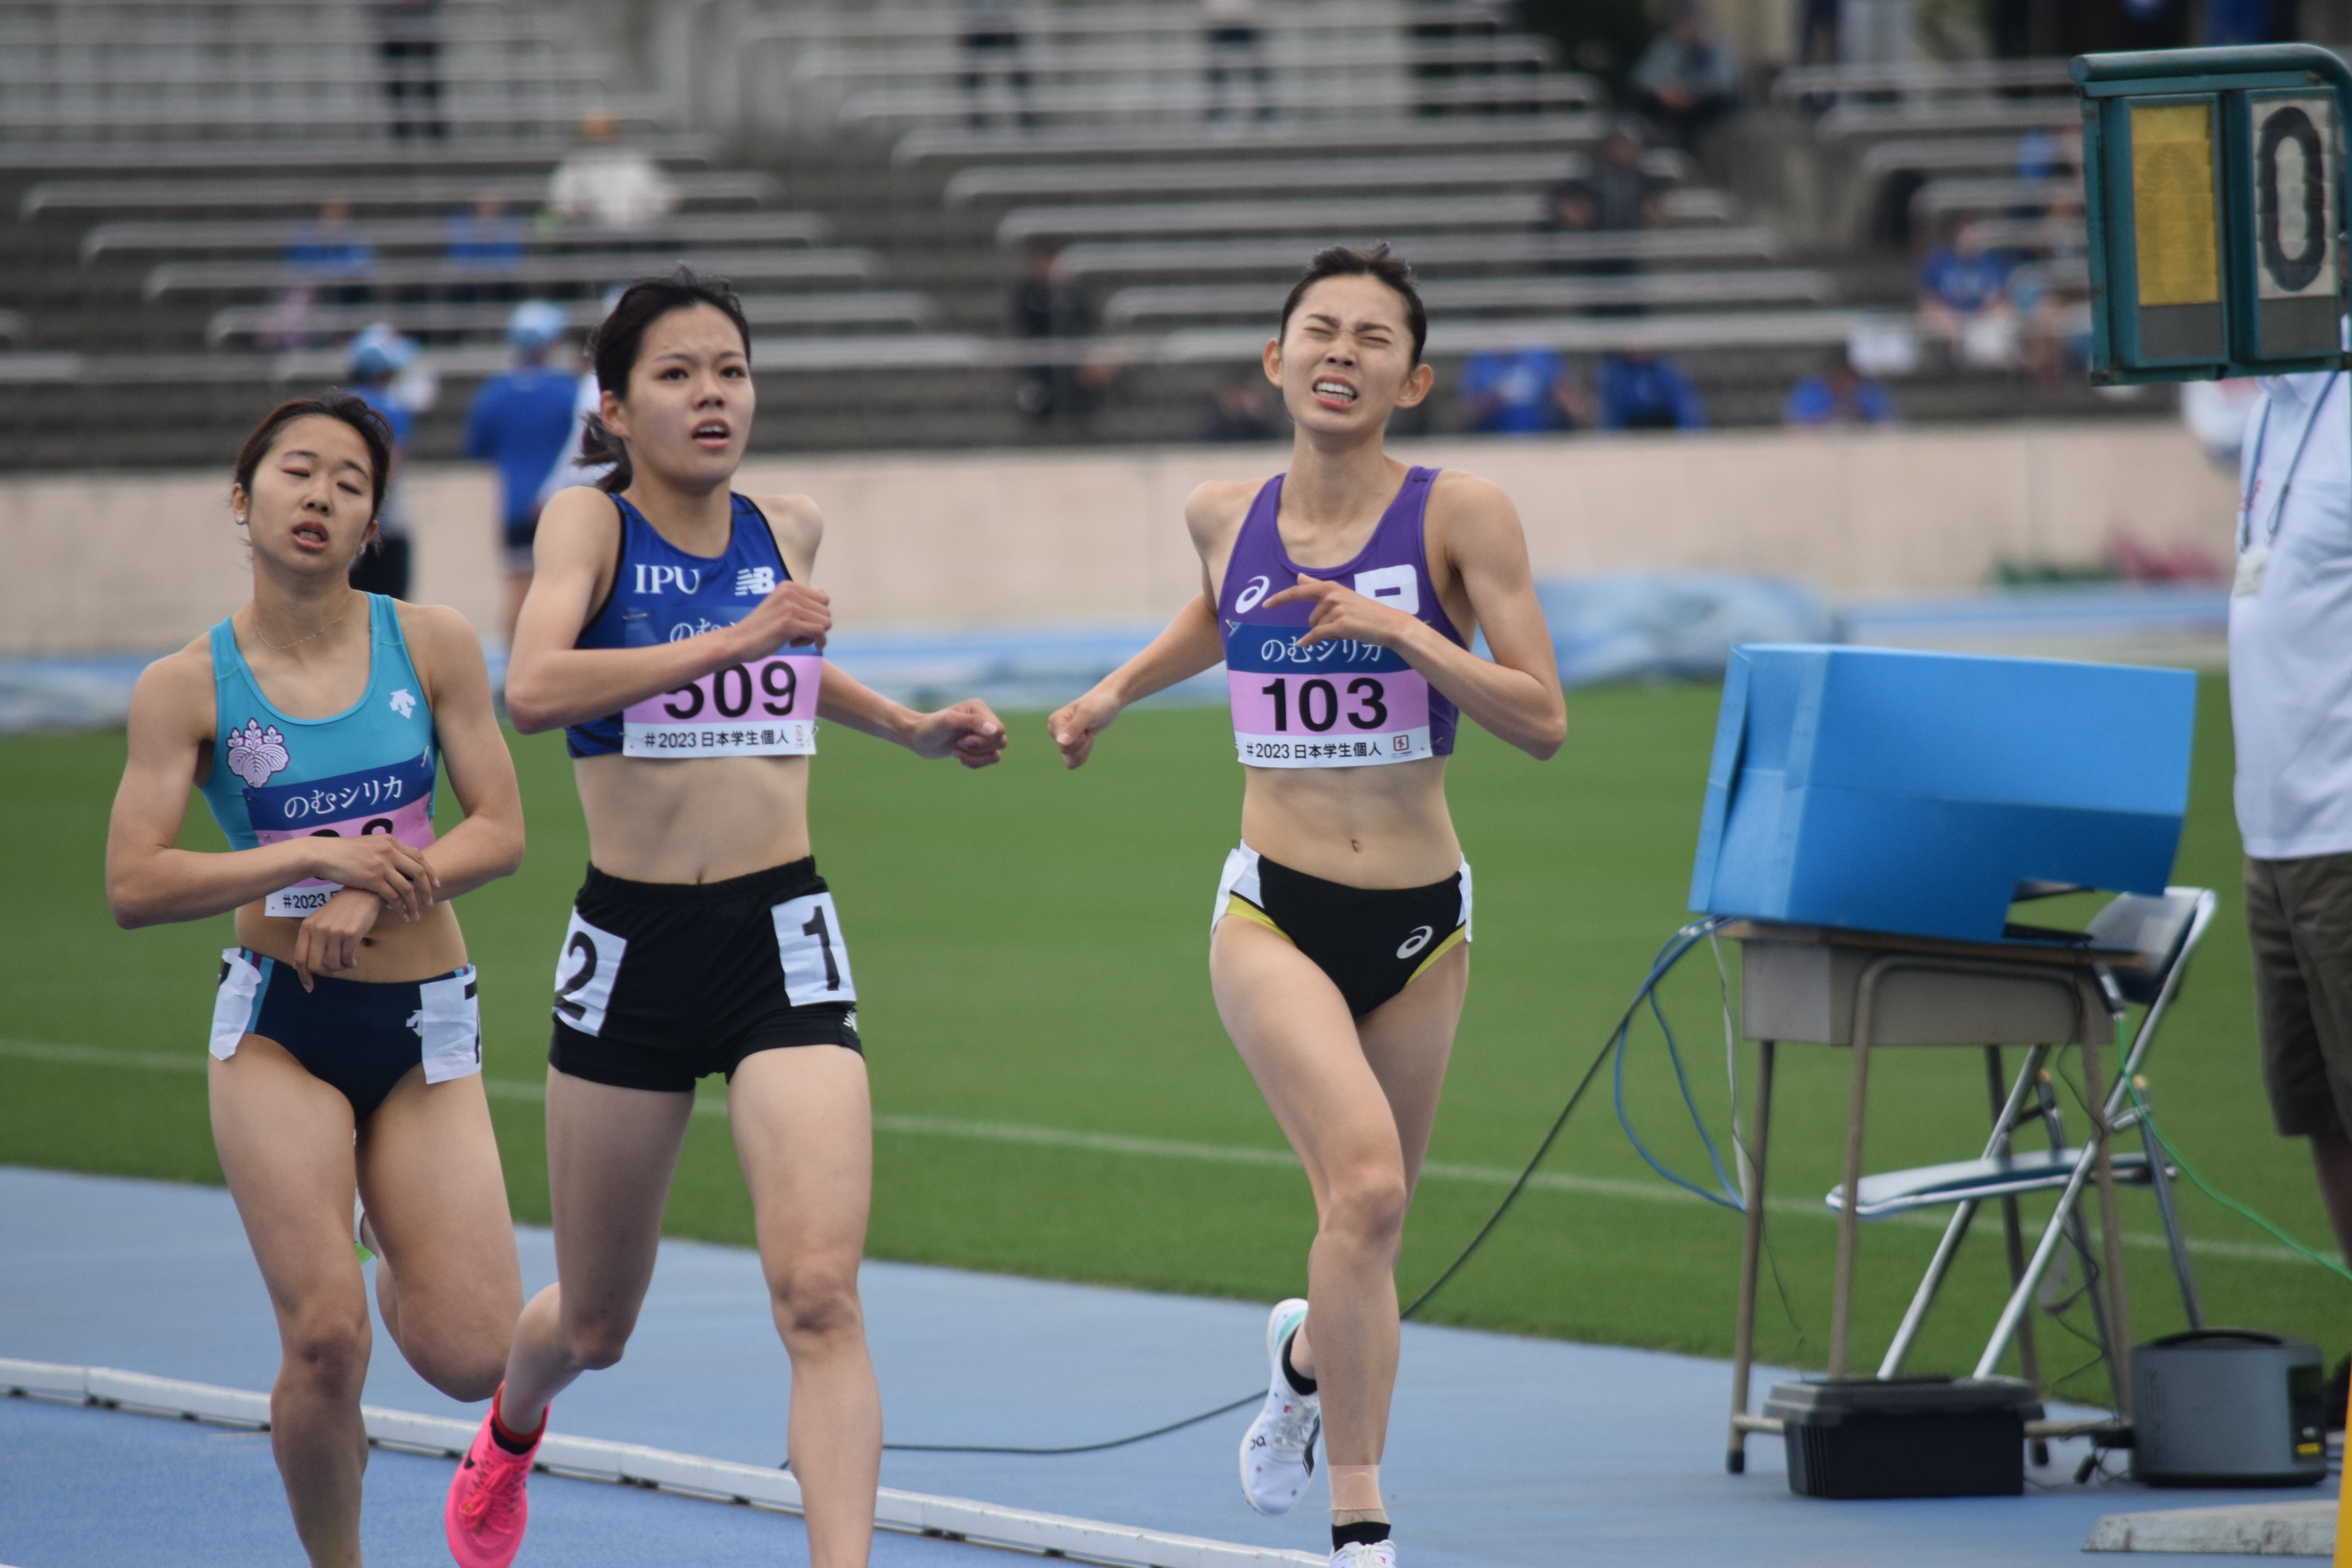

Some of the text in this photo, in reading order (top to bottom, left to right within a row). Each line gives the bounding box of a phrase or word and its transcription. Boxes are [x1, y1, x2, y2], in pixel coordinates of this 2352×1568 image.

[2257, 106, 2326, 292] 0
[634, 564, 699, 595] IPU
[1261, 636, 1384, 663] のむシリカ
[662, 660, 797, 720] 509
[1261, 677, 1388, 732] 103
[644, 729, 789, 749] #2023 日本学生個人
[1246, 742, 1290, 760] #2023
[1294, 741, 1383, 760] 日本学生個人
[283, 775, 403, 819] のむシリカ
[801, 905, 840, 992] 1
[553, 930, 597, 1022] 2
